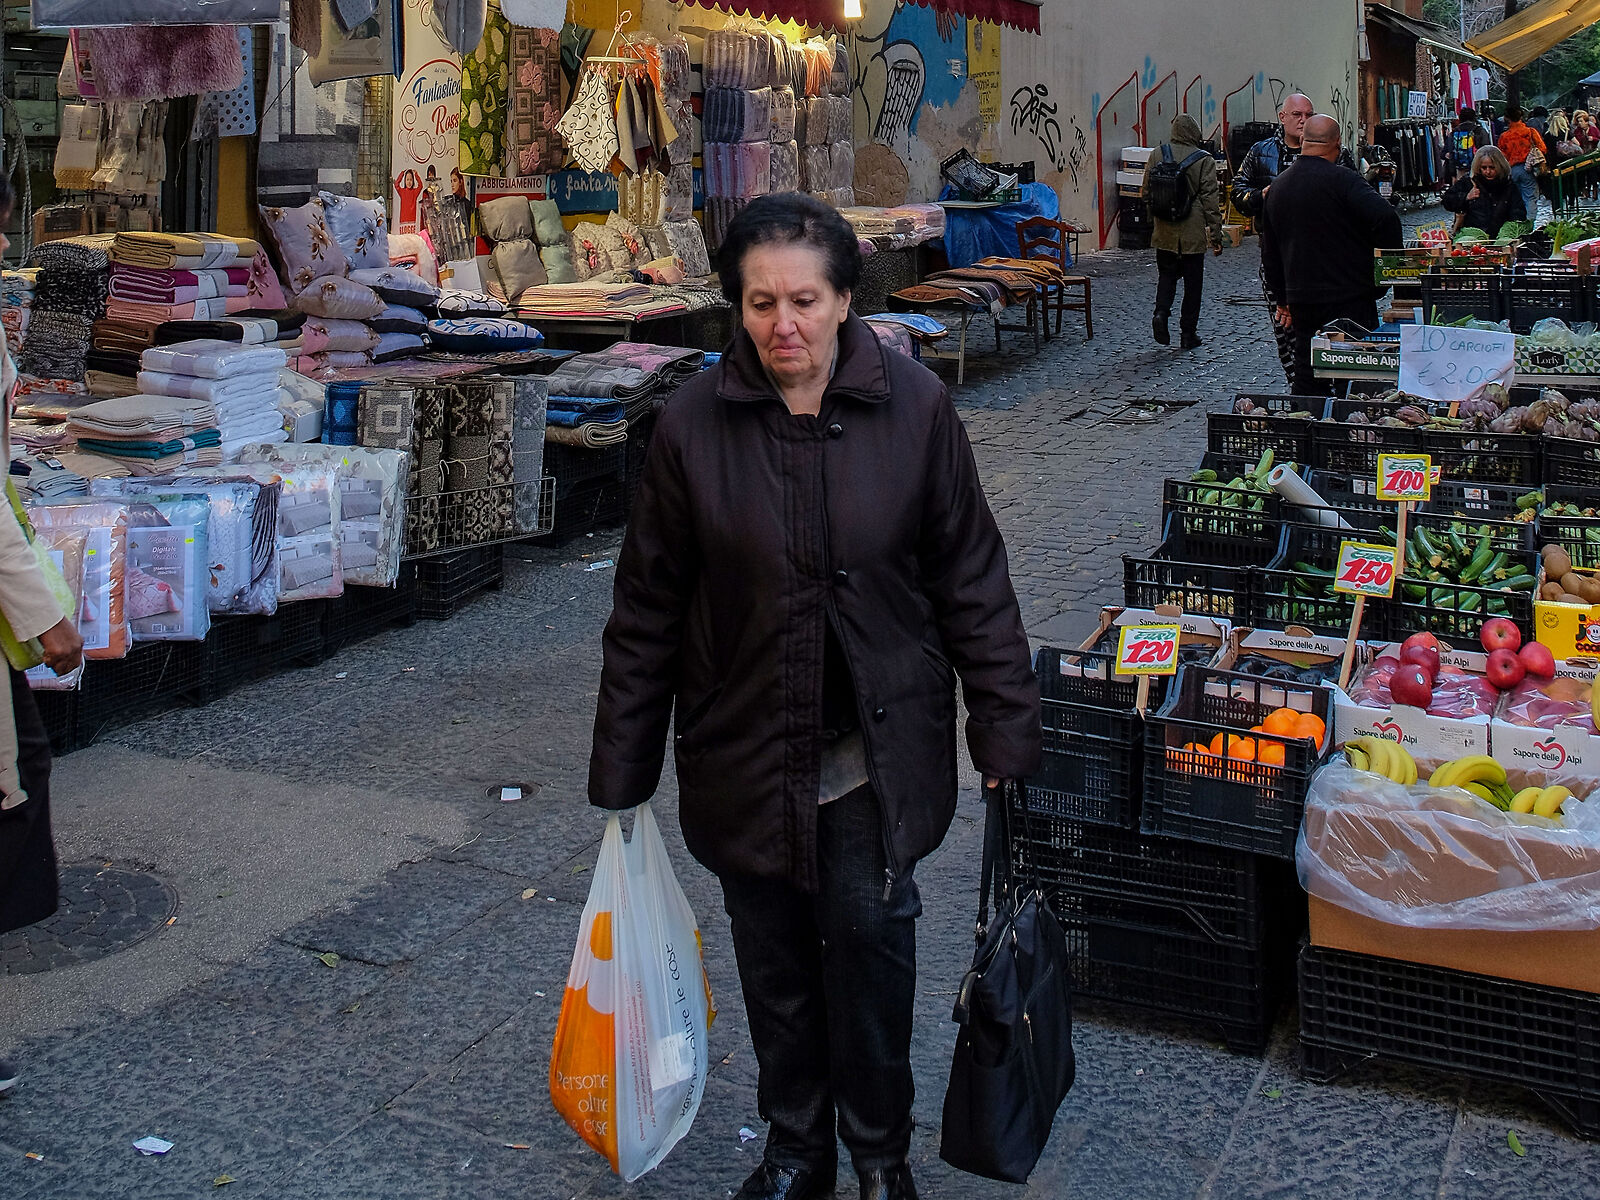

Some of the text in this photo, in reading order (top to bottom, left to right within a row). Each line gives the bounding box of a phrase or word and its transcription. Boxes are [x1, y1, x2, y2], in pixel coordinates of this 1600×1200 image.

[1410, 93, 1426, 104] TUTTO
[1408, 104, 1426, 116] 5.00
[431, 104, 460, 135] Ross
[481, 177, 543, 189] ABBIGLIAMENTO
[1411, 326, 1506, 353] 10 CARCIOFI
[1320, 351, 1400, 369] Sapore delle Alpi
[1182, 623, 1197, 634] Alpi
[1268, 637, 1330, 653] Sapore delle Alpi
[1453, 657, 1470, 669] Alpi
[1353, 727, 1418, 746] Sapore delle Alpi
[1512, 747, 1582, 766] Sapore delle Alpi
[674, 987, 686, 1005] le
[556, 1071, 609, 1091] Persone
